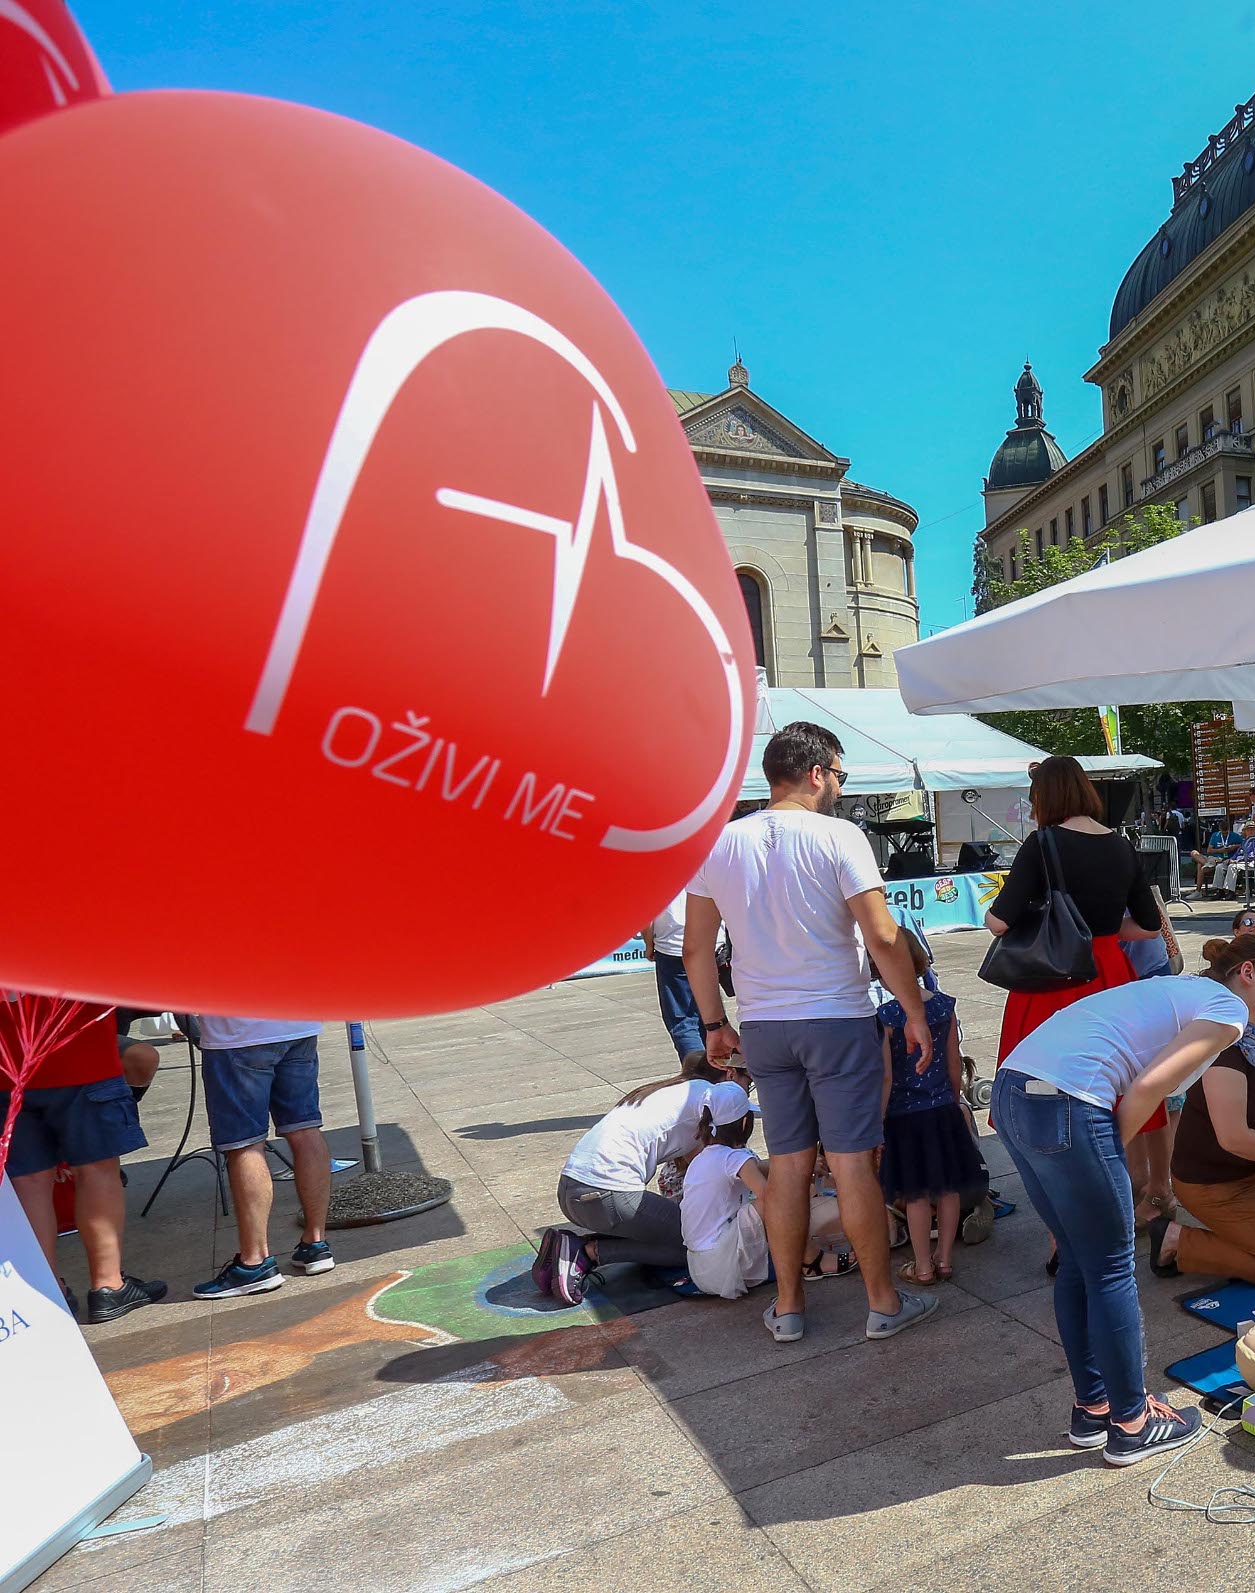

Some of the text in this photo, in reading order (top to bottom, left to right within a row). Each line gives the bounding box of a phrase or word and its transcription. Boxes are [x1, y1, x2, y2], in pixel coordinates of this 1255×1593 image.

[321, 706, 596, 841] OŽIVI ME
[885, 883, 925, 910] reb
[613, 949, 646, 962] među
[0, 1309, 31, 1342] BA
